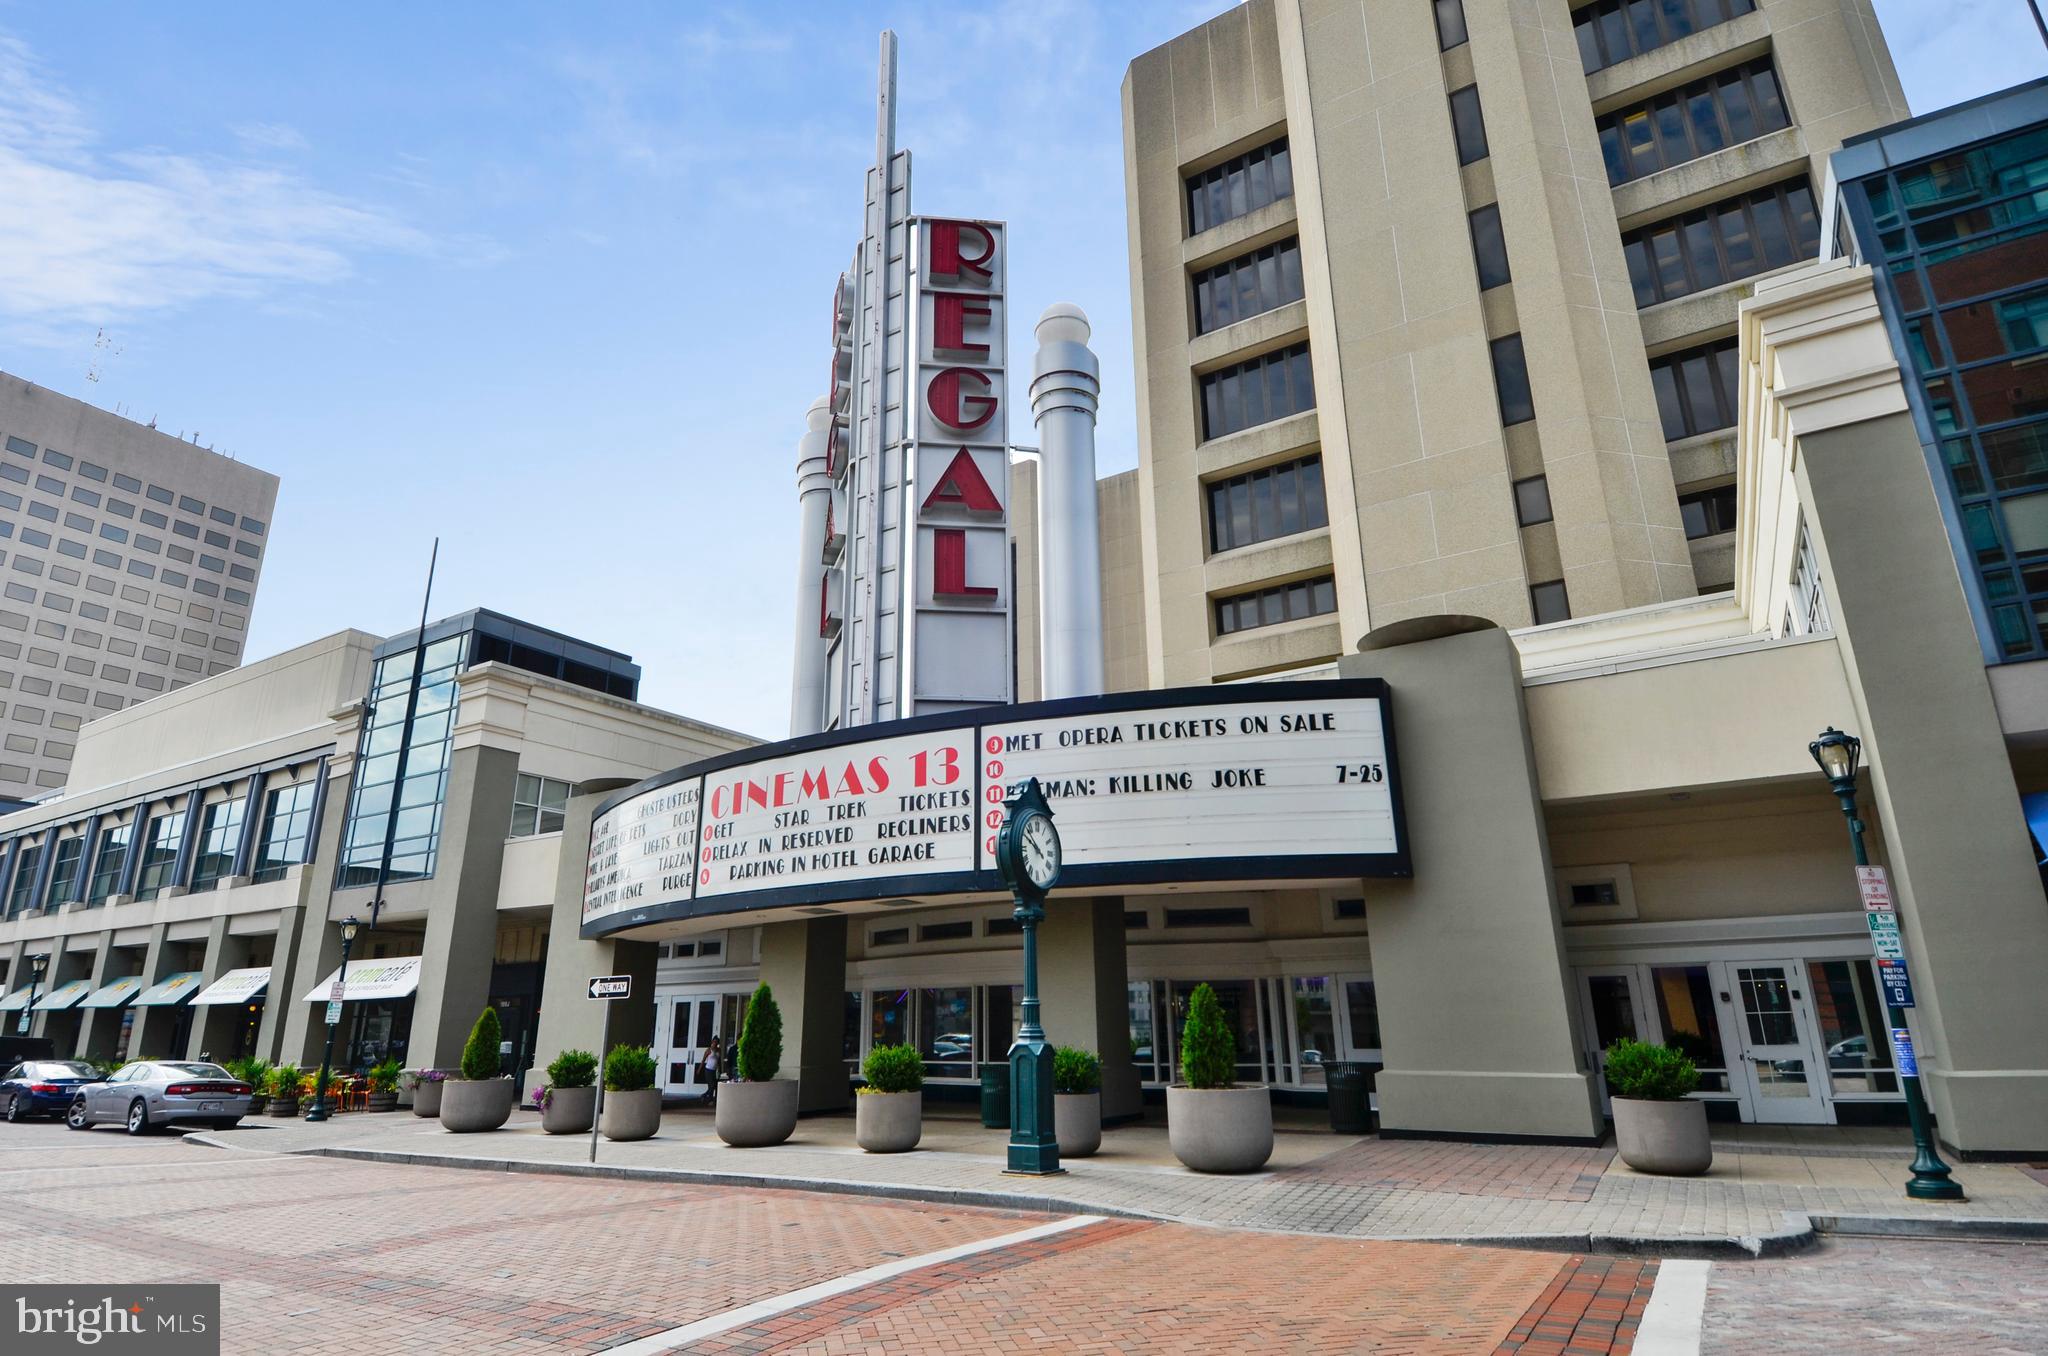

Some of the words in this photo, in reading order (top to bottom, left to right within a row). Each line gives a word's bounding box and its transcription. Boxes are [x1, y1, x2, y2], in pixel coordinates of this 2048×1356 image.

[920, 219, 1004, 601] REGAL
[1005, 732, 1043, 752] MET
[1058, 726, 1123, 748] OPERA
[1133, 718, 1228, 741] TICKETS
[1240, 715, 1269, 734] ON
[1280, 712, 1336, 732] SALE
[711, 755, 890, 820] CINEMAS
[908, 747, 961, 788] 13
[1109, 771, 1193, 794] KILLING
[1211, 767, 1267, 789] JOKE
[1336, 763, 1383, 784] 7-25
[672, 808, 698, 828] DORY
[714, 822, 735, 840] GET
[773, 808, 810, 829] STAR
[827, 800, 867, 822] TREK
[898, 788, 971, 813] TICKETS
[676, 829, 696, 846] OUT
[712, 840, 748, 861] RELAX
[758, 837, 772, 854] IN
[782, 826, 854, 851] RESERVED
[877, 814, 971, 840] RECLINERS
[657, 850, 693, 873] TARZAN
[729, 858, 785, 881] PARKING
[791, 856, 807, 873] IN
[812, 849, 858, 870] HOTEL
[867, 842, 936, 865] GARAGE
[662, 871, 693, 893] PURGE
[599, 984, 611, 993] ONE
[612, 983, 626, 992] WAY
